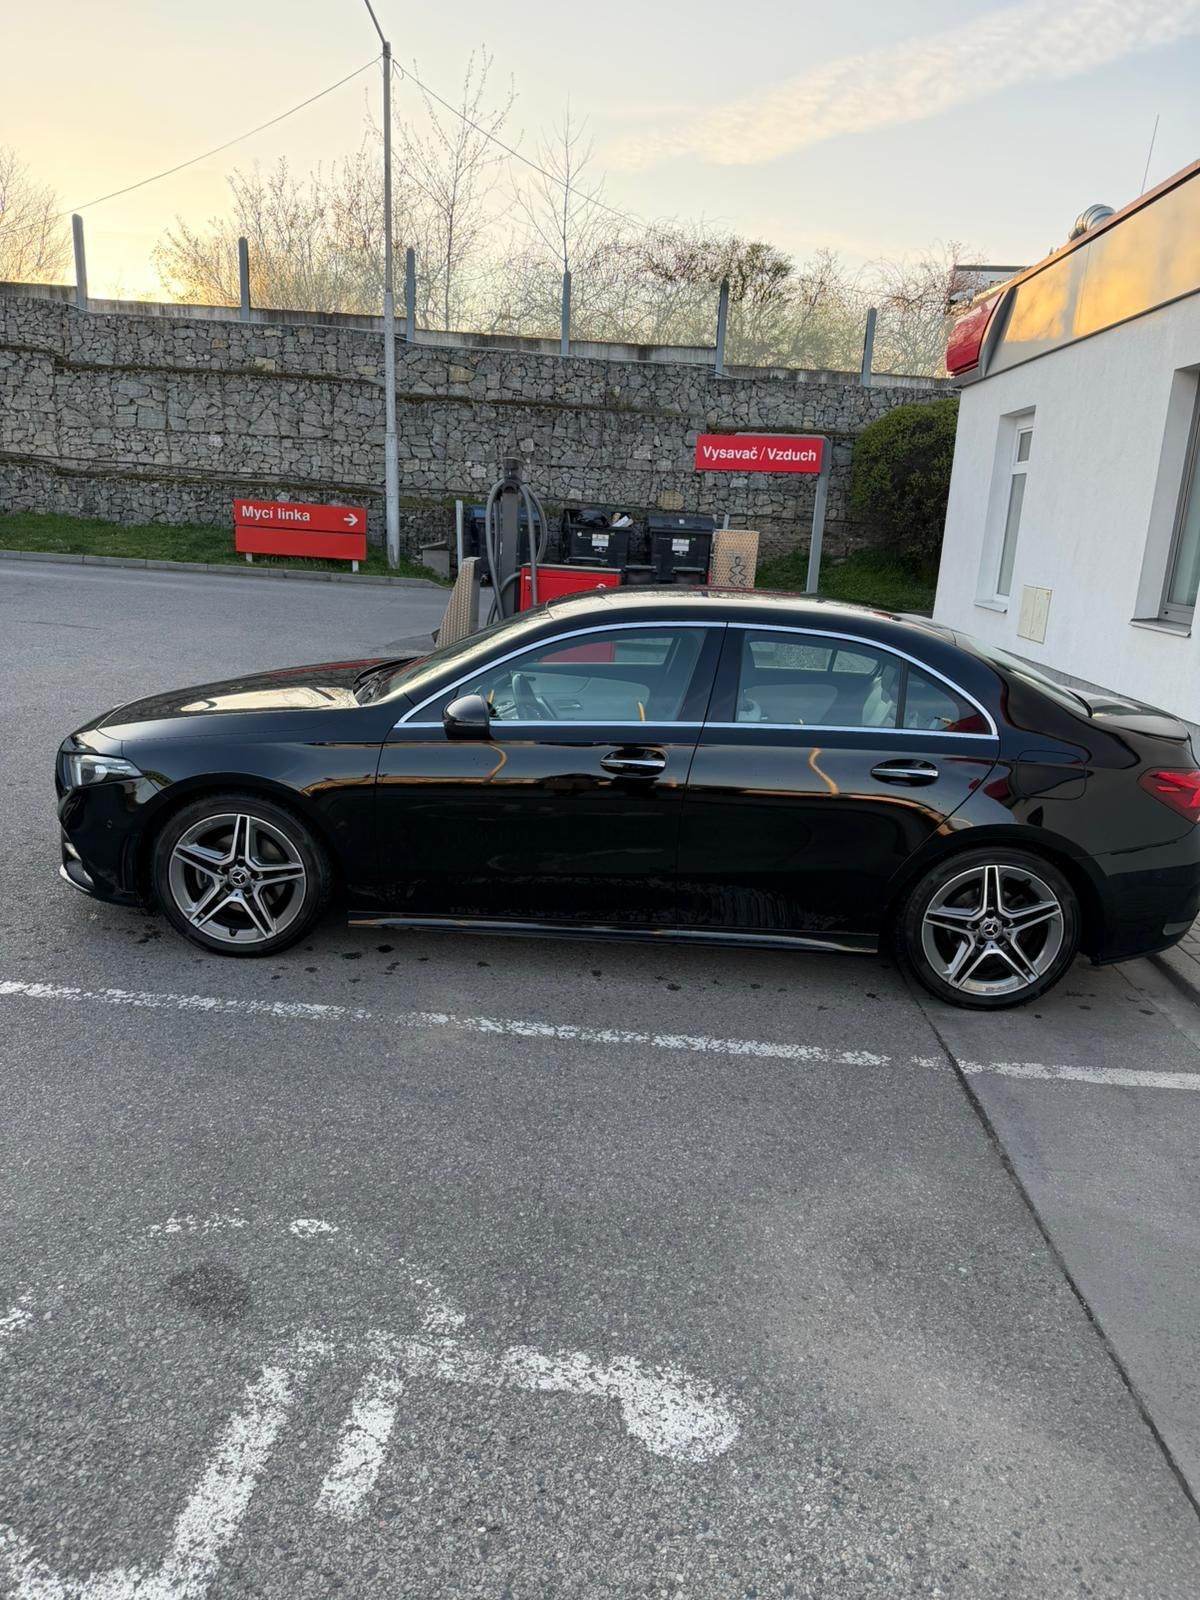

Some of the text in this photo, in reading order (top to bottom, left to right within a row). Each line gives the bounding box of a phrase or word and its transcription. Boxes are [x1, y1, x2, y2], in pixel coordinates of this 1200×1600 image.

[703, 446, 758, 461] Vysavač
[767, 447, 817, 461] Vzduch
[241, 505, 310, 521] Mycí linka
